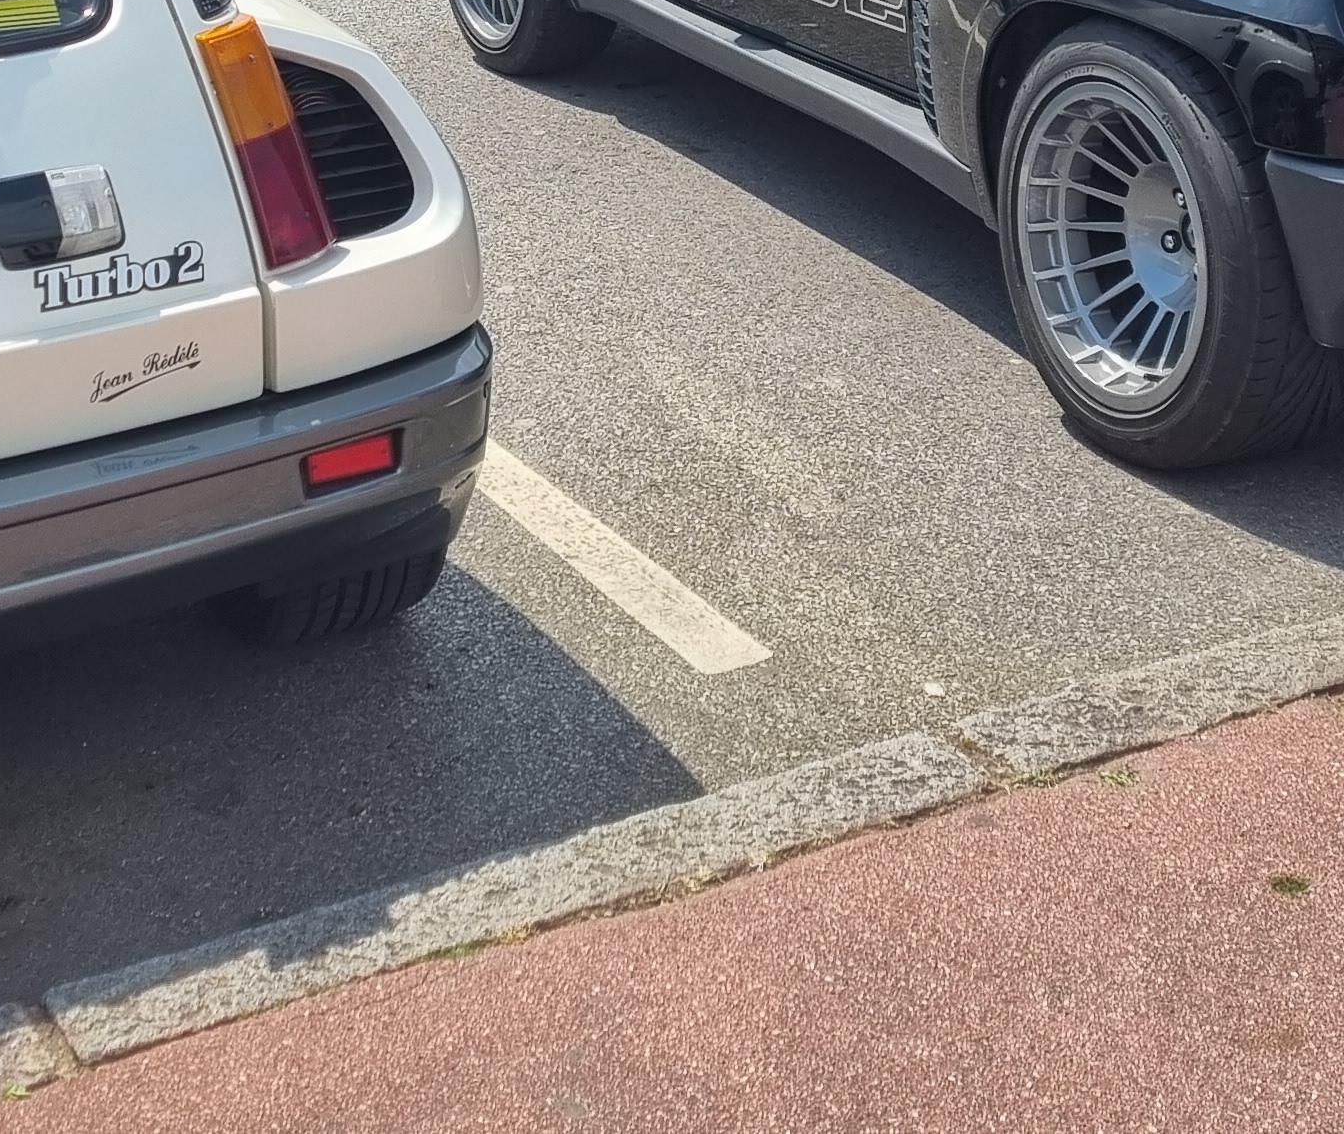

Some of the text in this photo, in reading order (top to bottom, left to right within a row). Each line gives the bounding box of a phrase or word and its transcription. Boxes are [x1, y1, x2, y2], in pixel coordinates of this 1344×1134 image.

[37, 240, 204, 309] Turbo 2
[90, 340, 200, 404] Jean Rédélé
